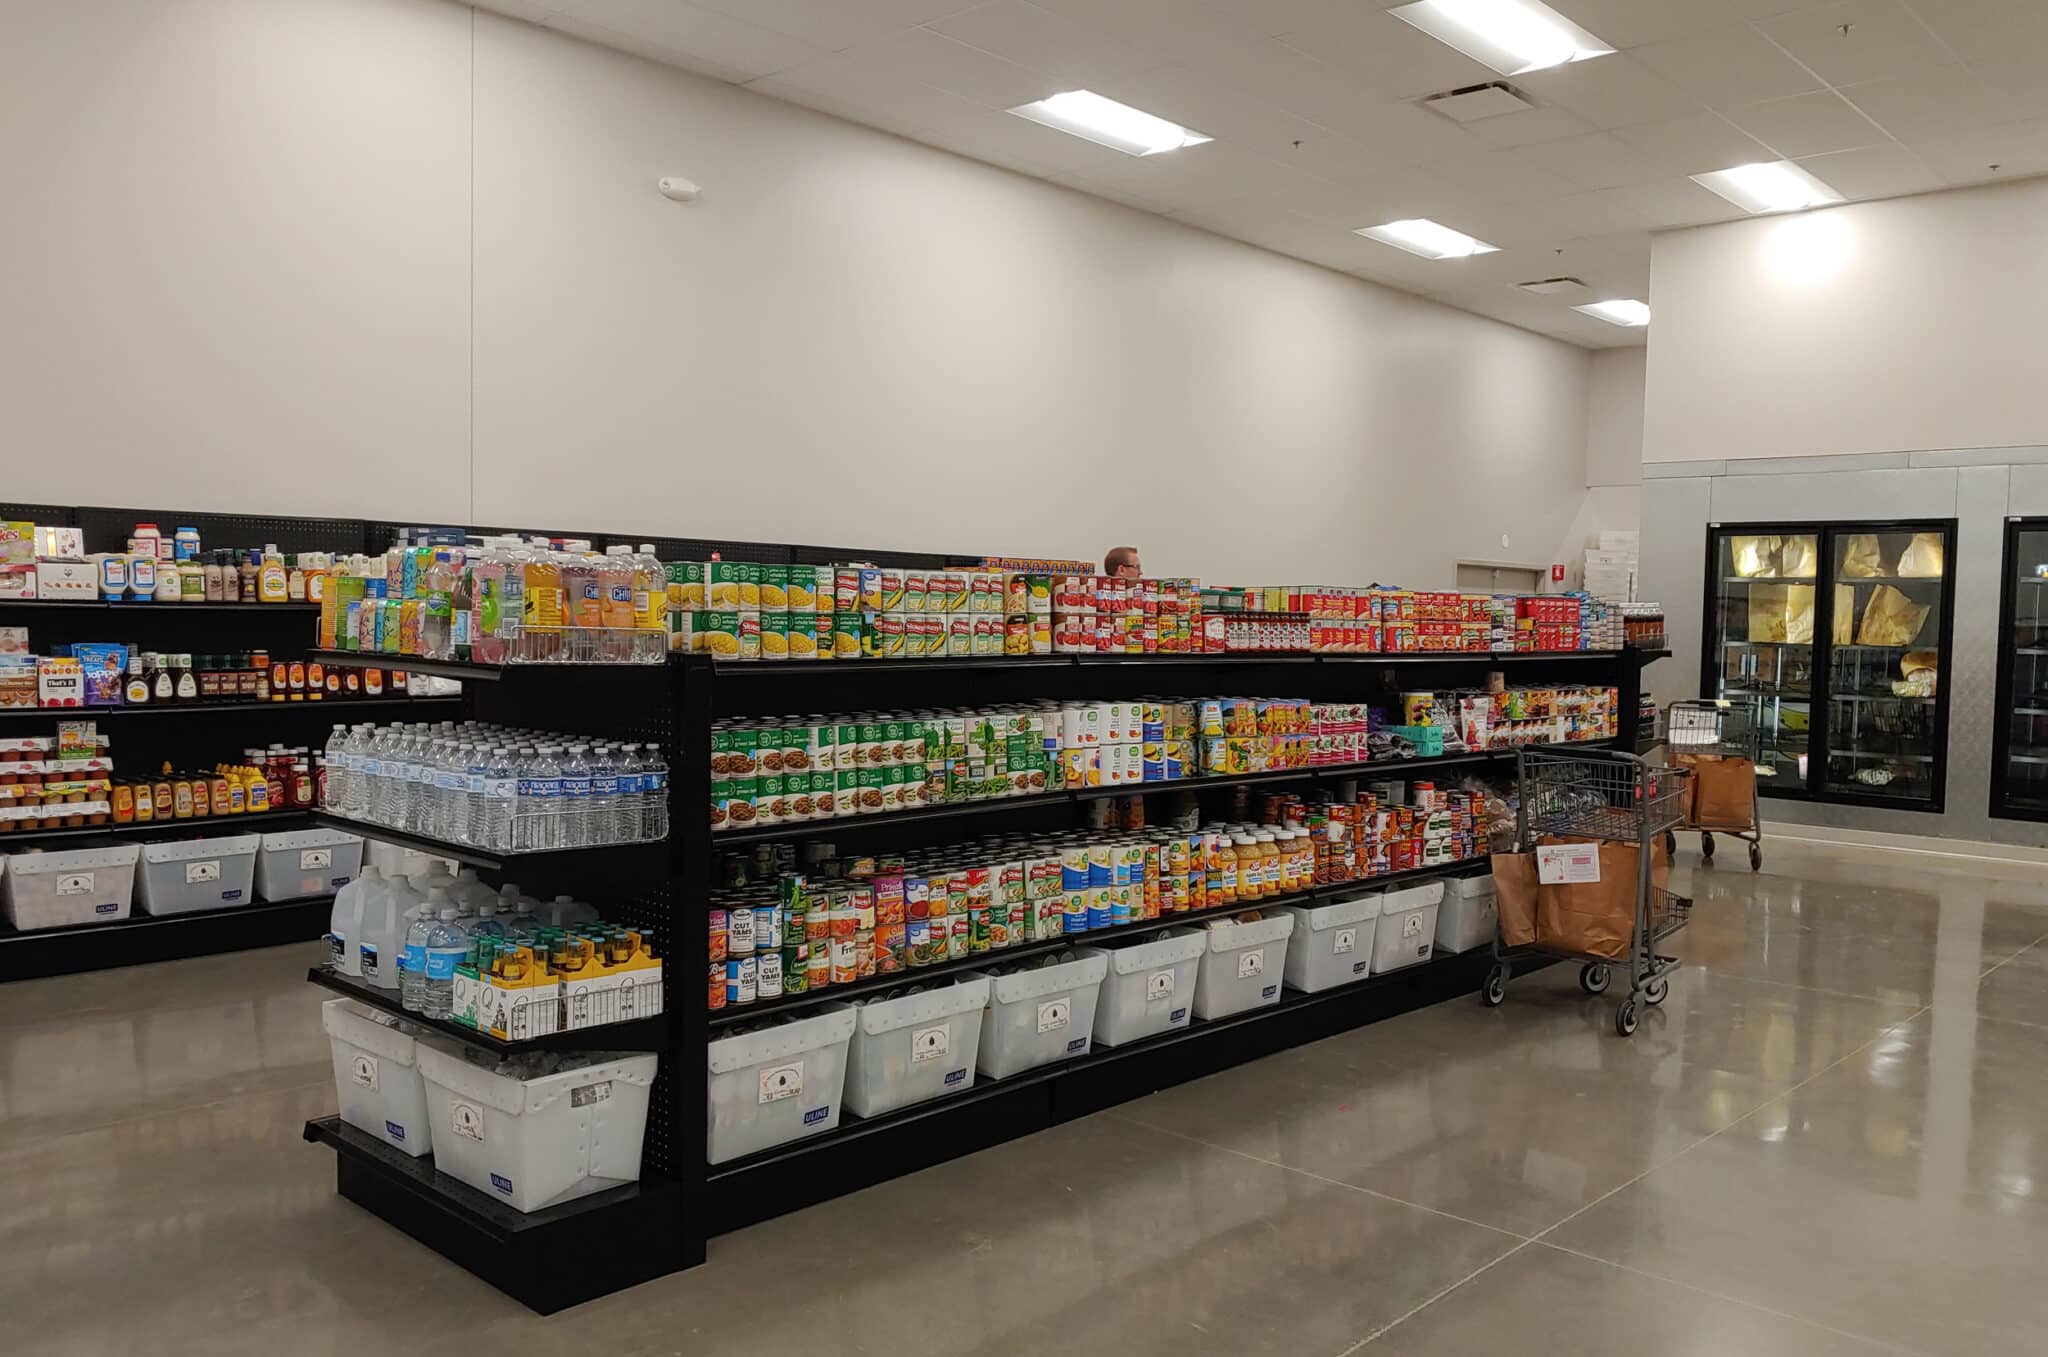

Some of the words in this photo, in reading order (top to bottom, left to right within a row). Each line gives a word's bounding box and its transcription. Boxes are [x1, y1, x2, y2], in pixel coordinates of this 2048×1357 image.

[1067, 1038, 1086, 1051] ULINE
[945, 1069, 966, 1083] ULINE
[804, 1107, 828, 1123] ULINE
[491, 1173, 512, 1192] ULINE
